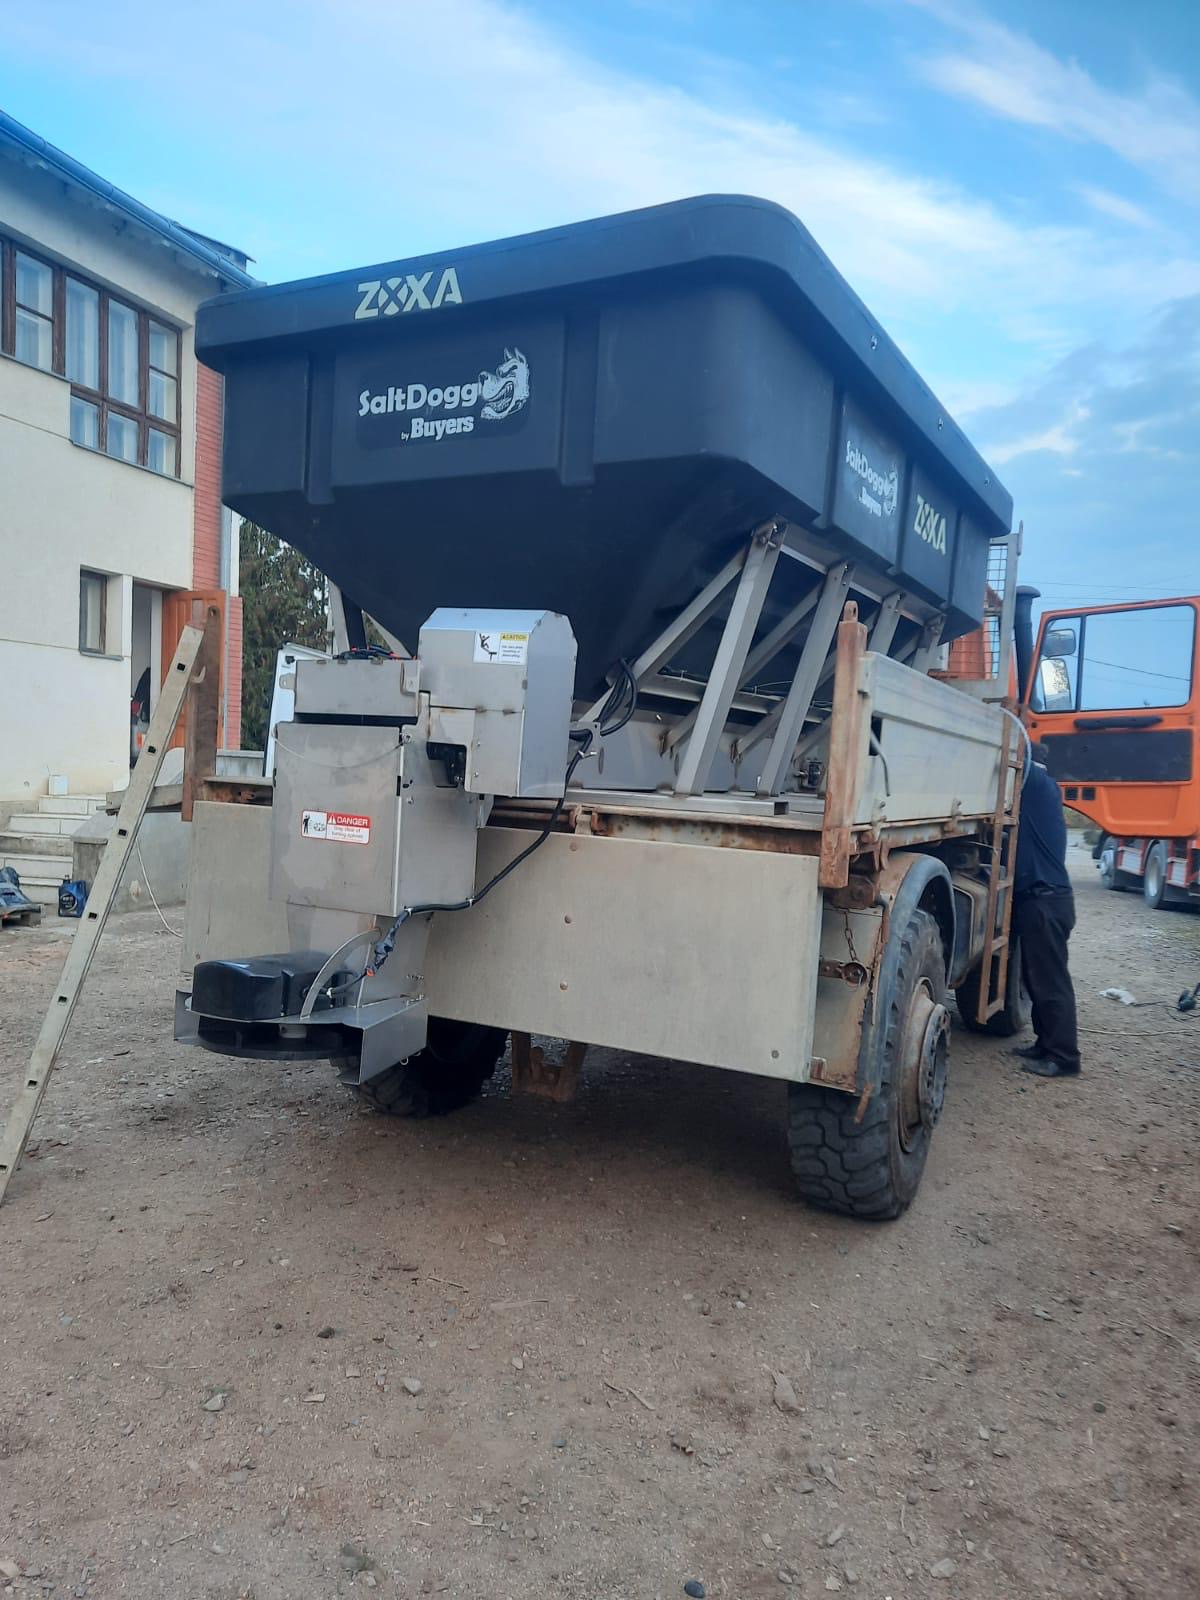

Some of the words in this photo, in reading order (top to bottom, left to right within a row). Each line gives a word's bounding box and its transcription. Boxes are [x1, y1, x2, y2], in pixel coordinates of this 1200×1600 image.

[358, 381, 479, 417] SaltDogg
[410, 415, 475, 441] Buyers
[336, 816, 368, 827] DANGER
